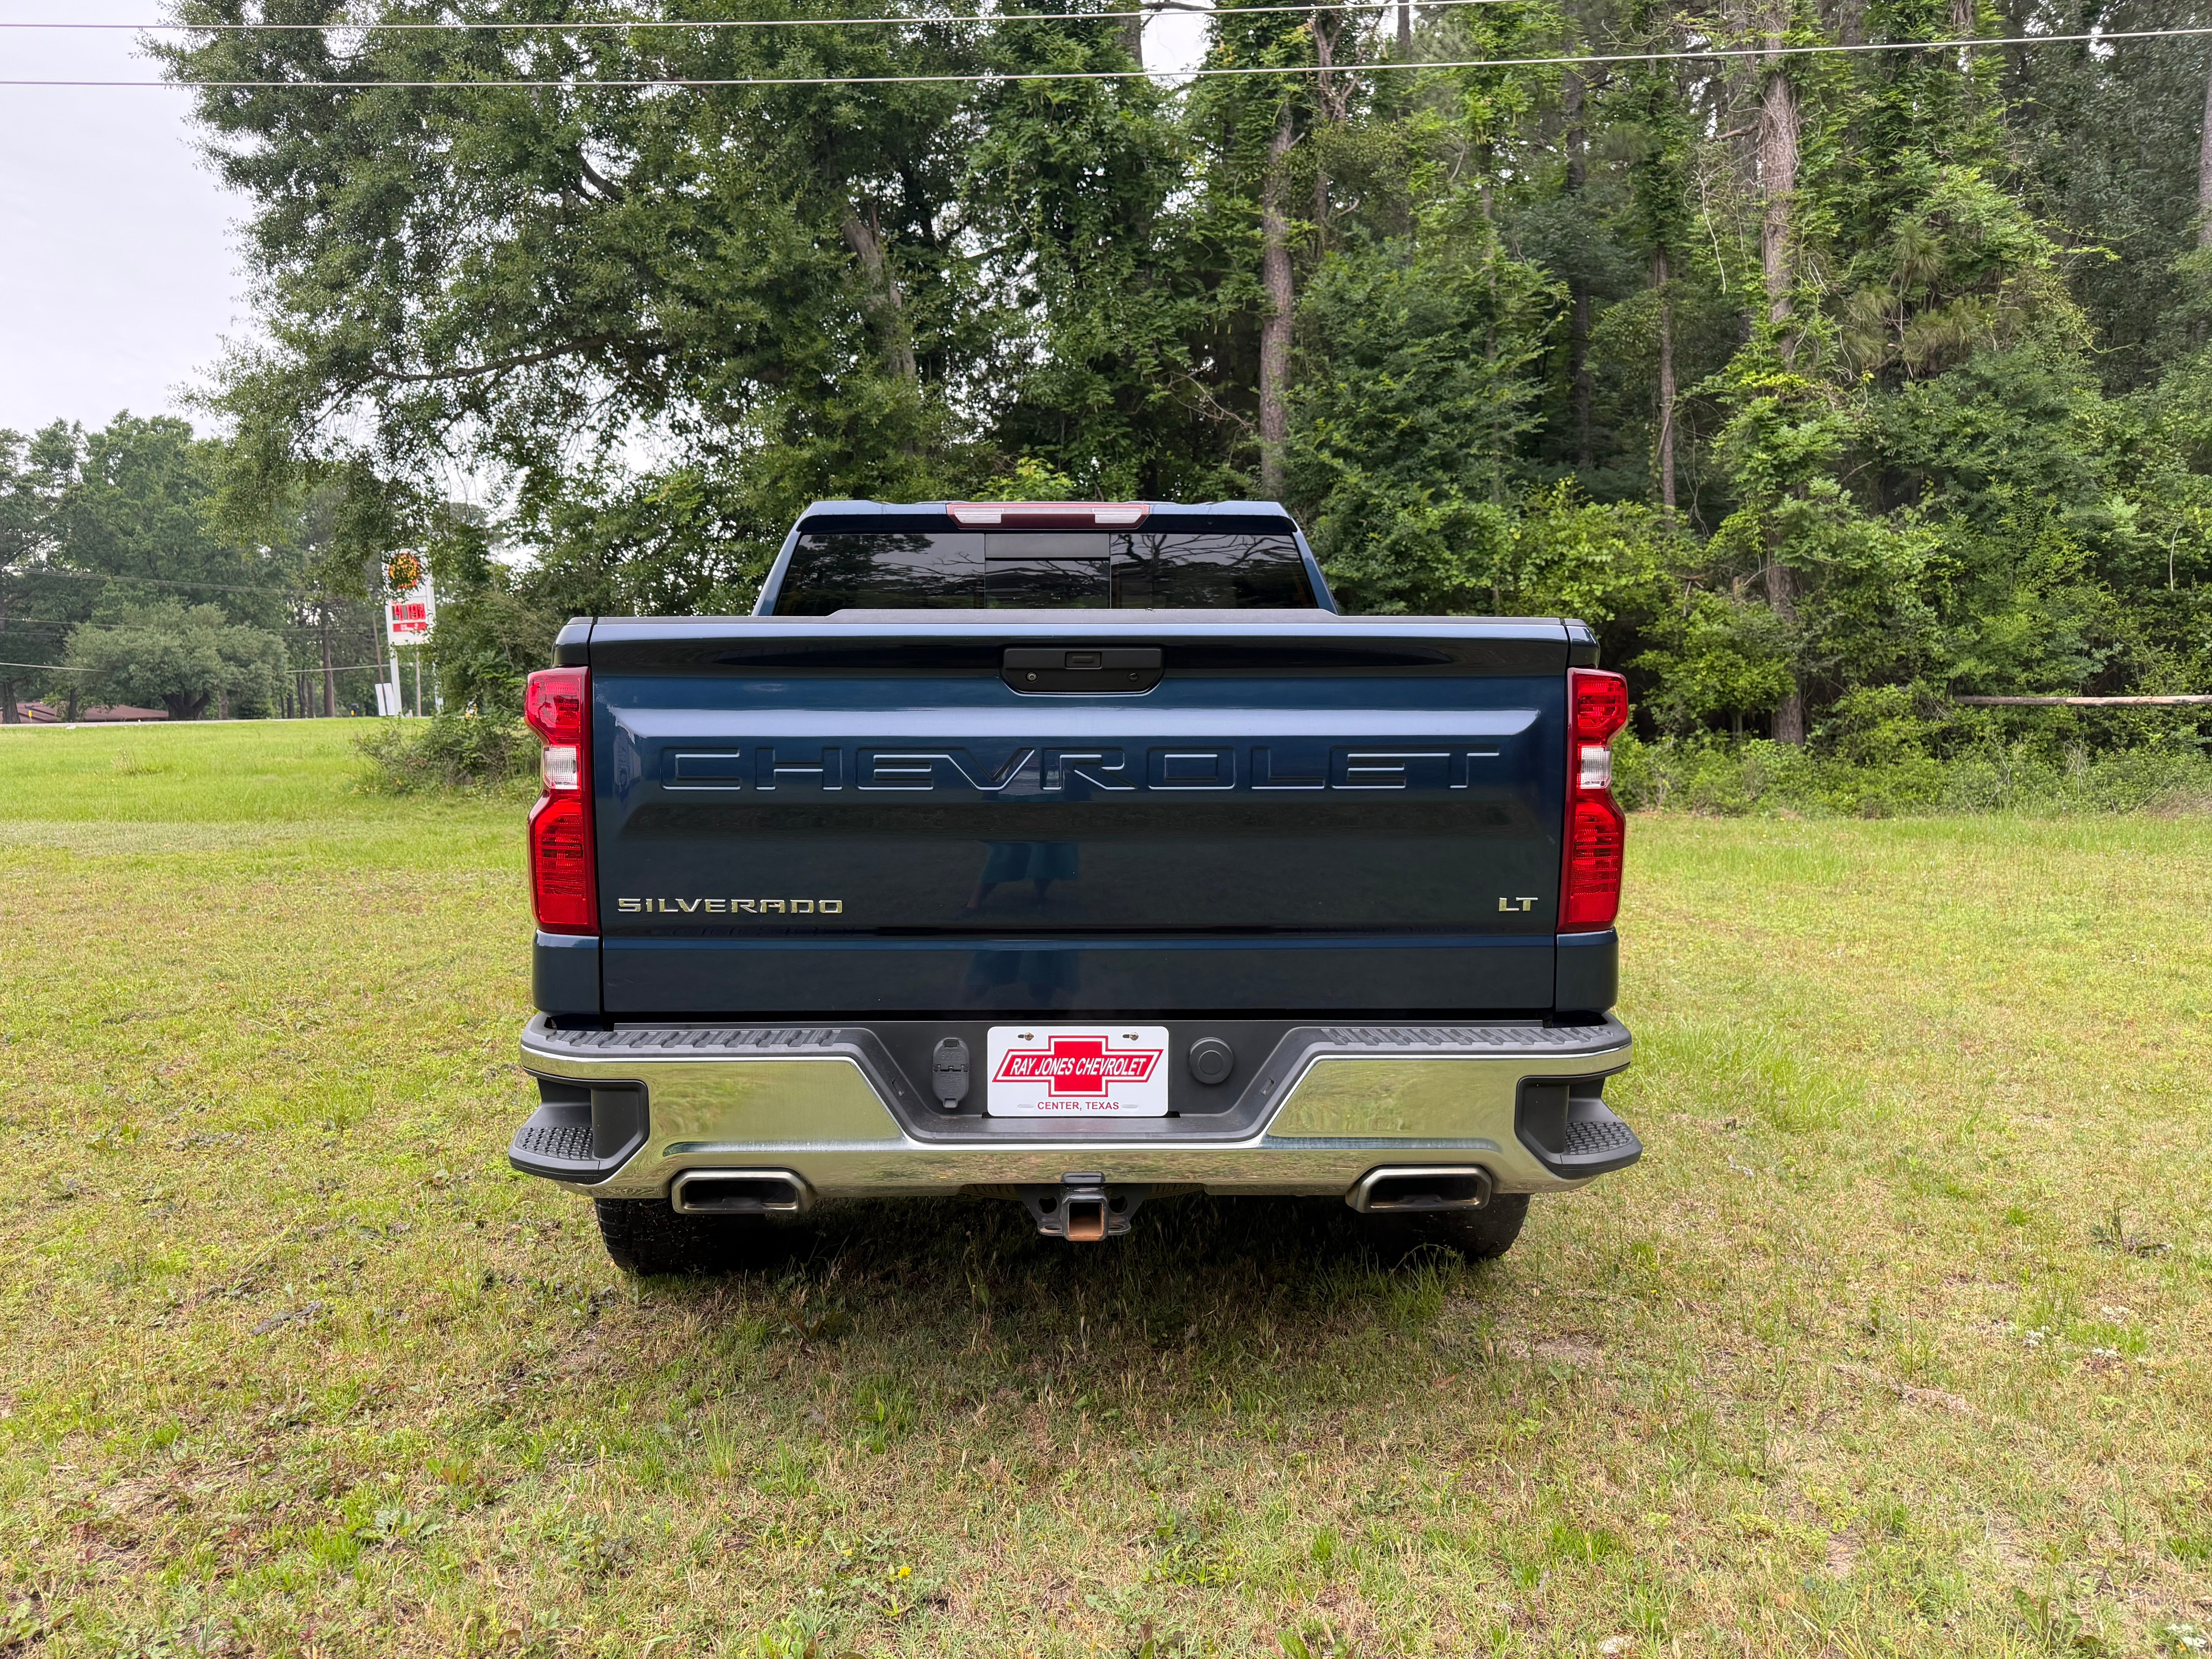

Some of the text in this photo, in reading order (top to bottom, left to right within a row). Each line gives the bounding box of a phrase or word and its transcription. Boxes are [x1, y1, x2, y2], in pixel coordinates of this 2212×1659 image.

[661, 744, 1499, 790] CHEVROLET
[618, 898, 843, 914] SILVERADO
[1499, 897, 1538, 911] LT
[1010, 1058, 1146, 1075] RAY JONES CHEVROLET
[1037, 1102, 1082, 1111] CENTER,
